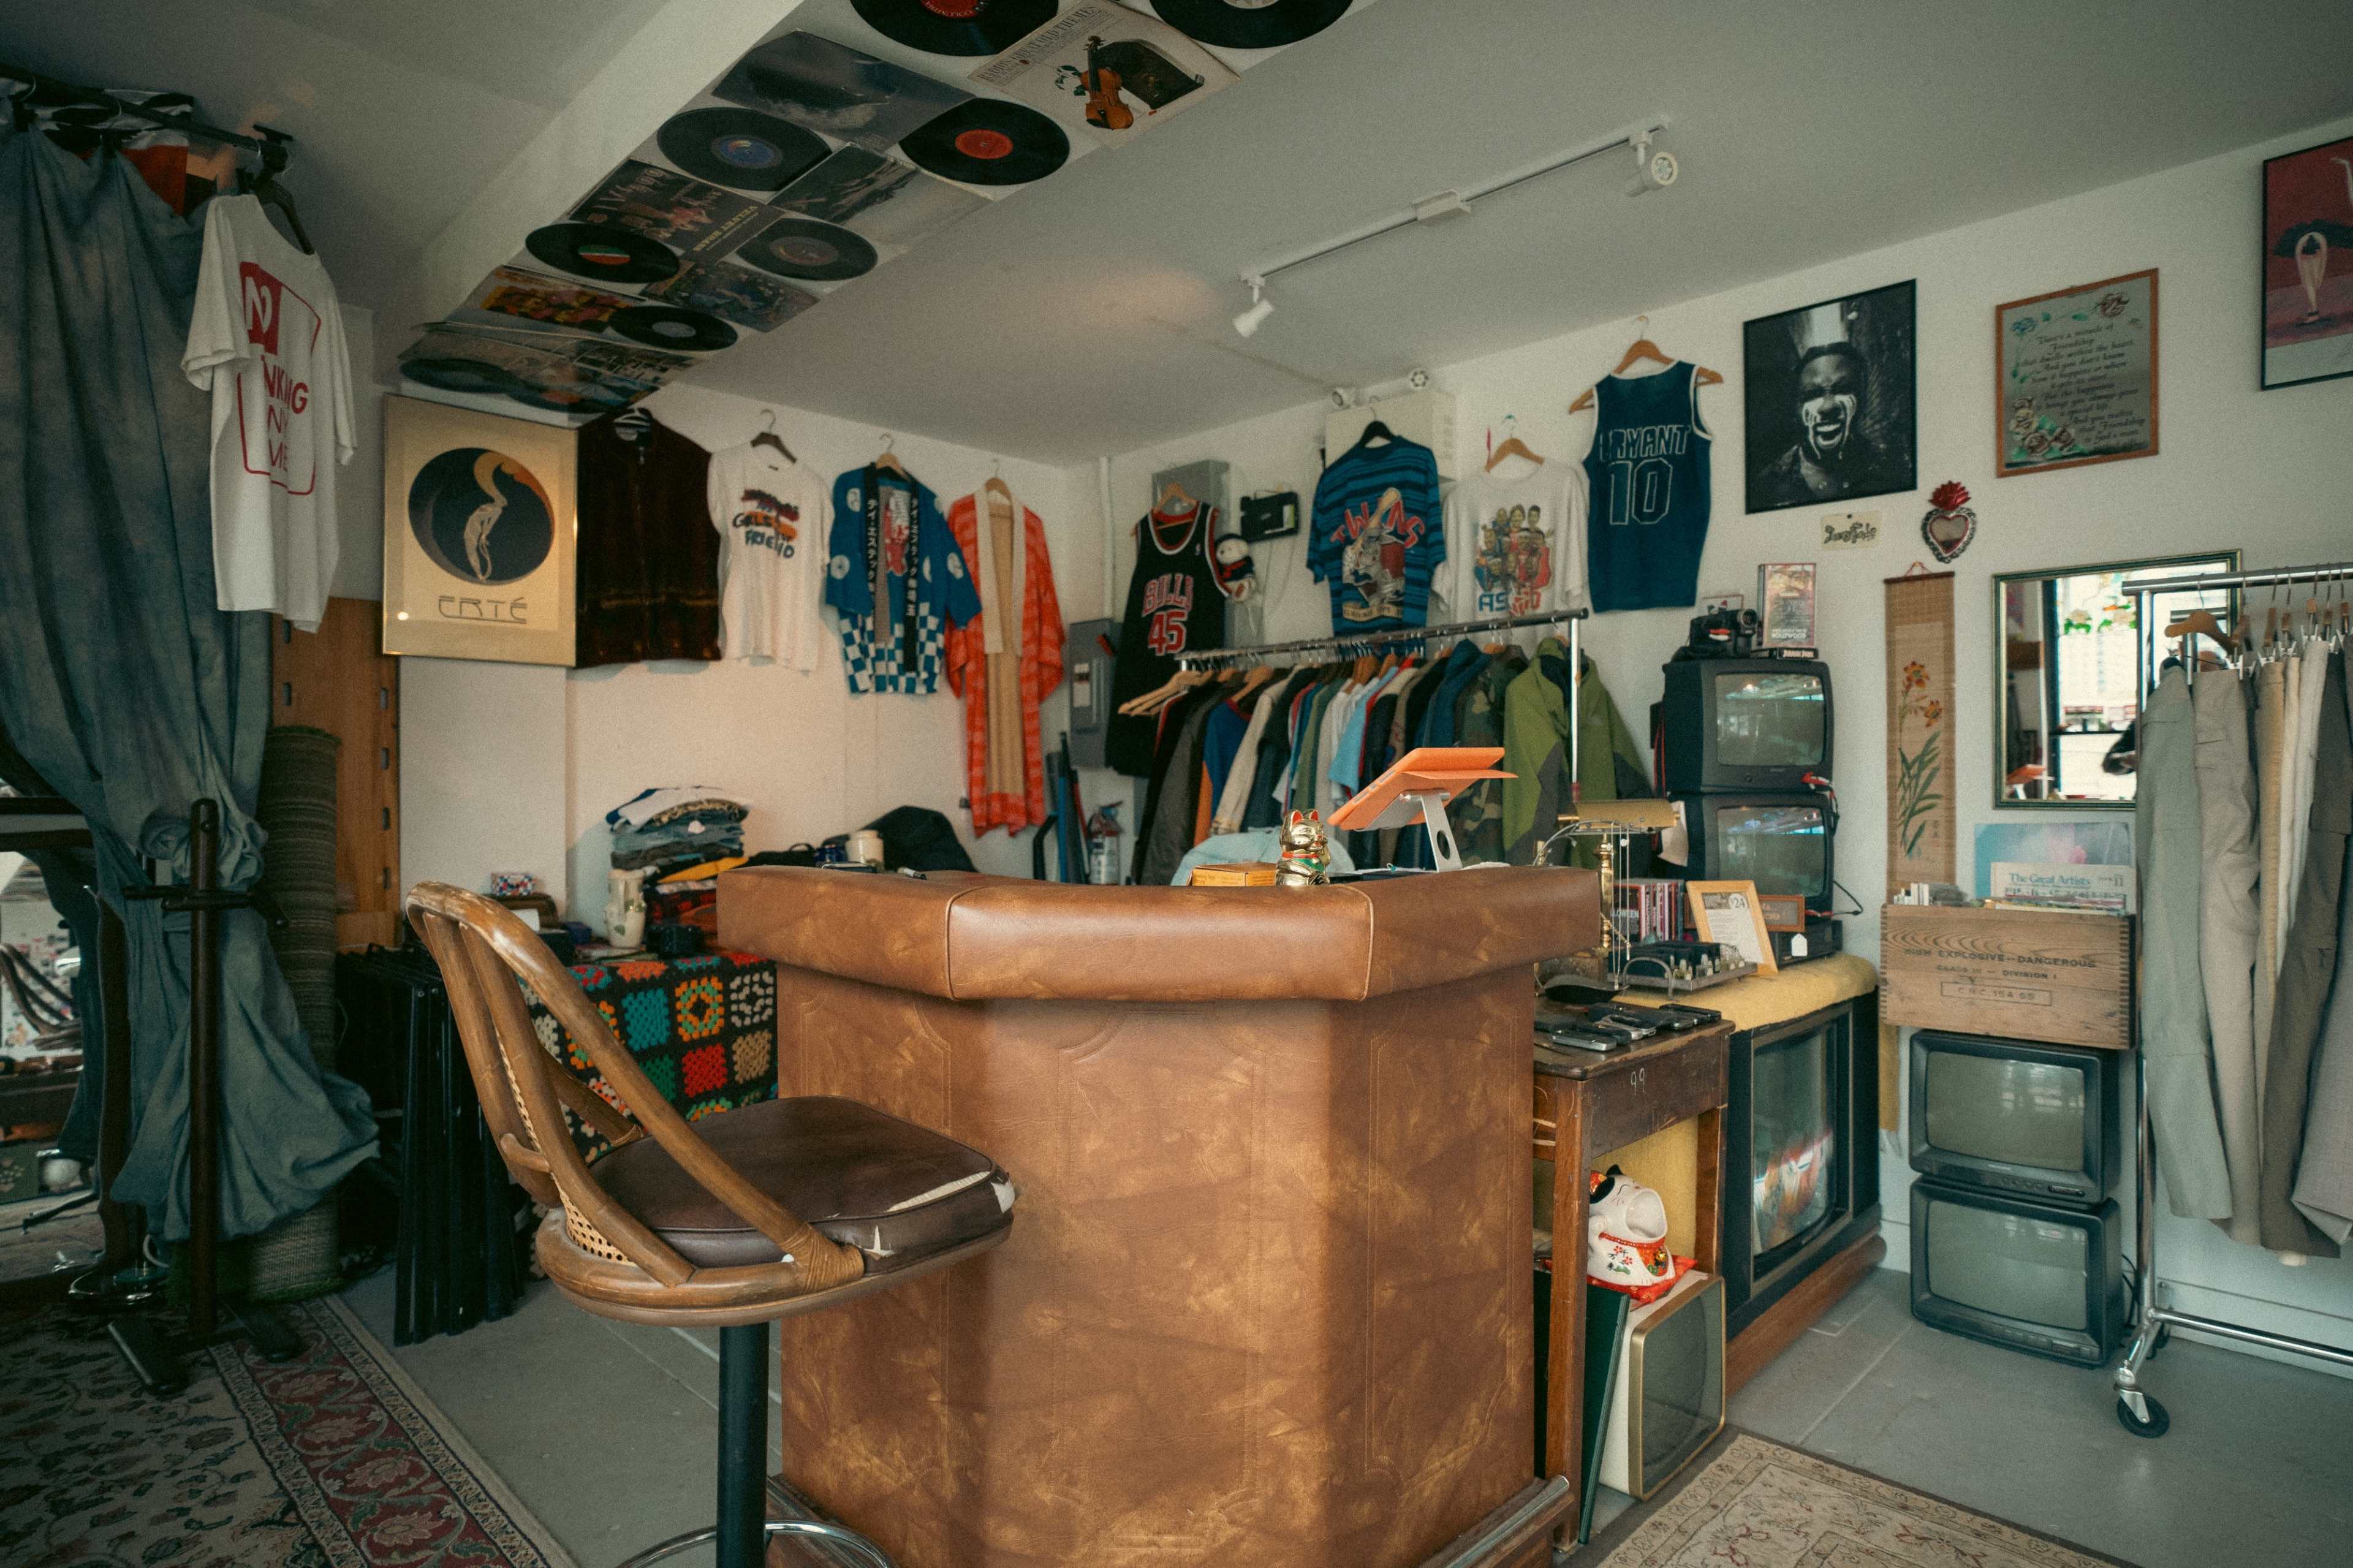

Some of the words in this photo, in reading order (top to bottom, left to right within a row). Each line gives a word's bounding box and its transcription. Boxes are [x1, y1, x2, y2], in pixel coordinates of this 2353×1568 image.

[1607, 458, 1673, 526] 10
[1330, 498, 1426, 549] TWNS
[1148, 608, 1188, 657] 45
[1937, 950, 2004, 963] EXPLOSIVE
[2017, 955, 2097, 969] DANGEROUS
